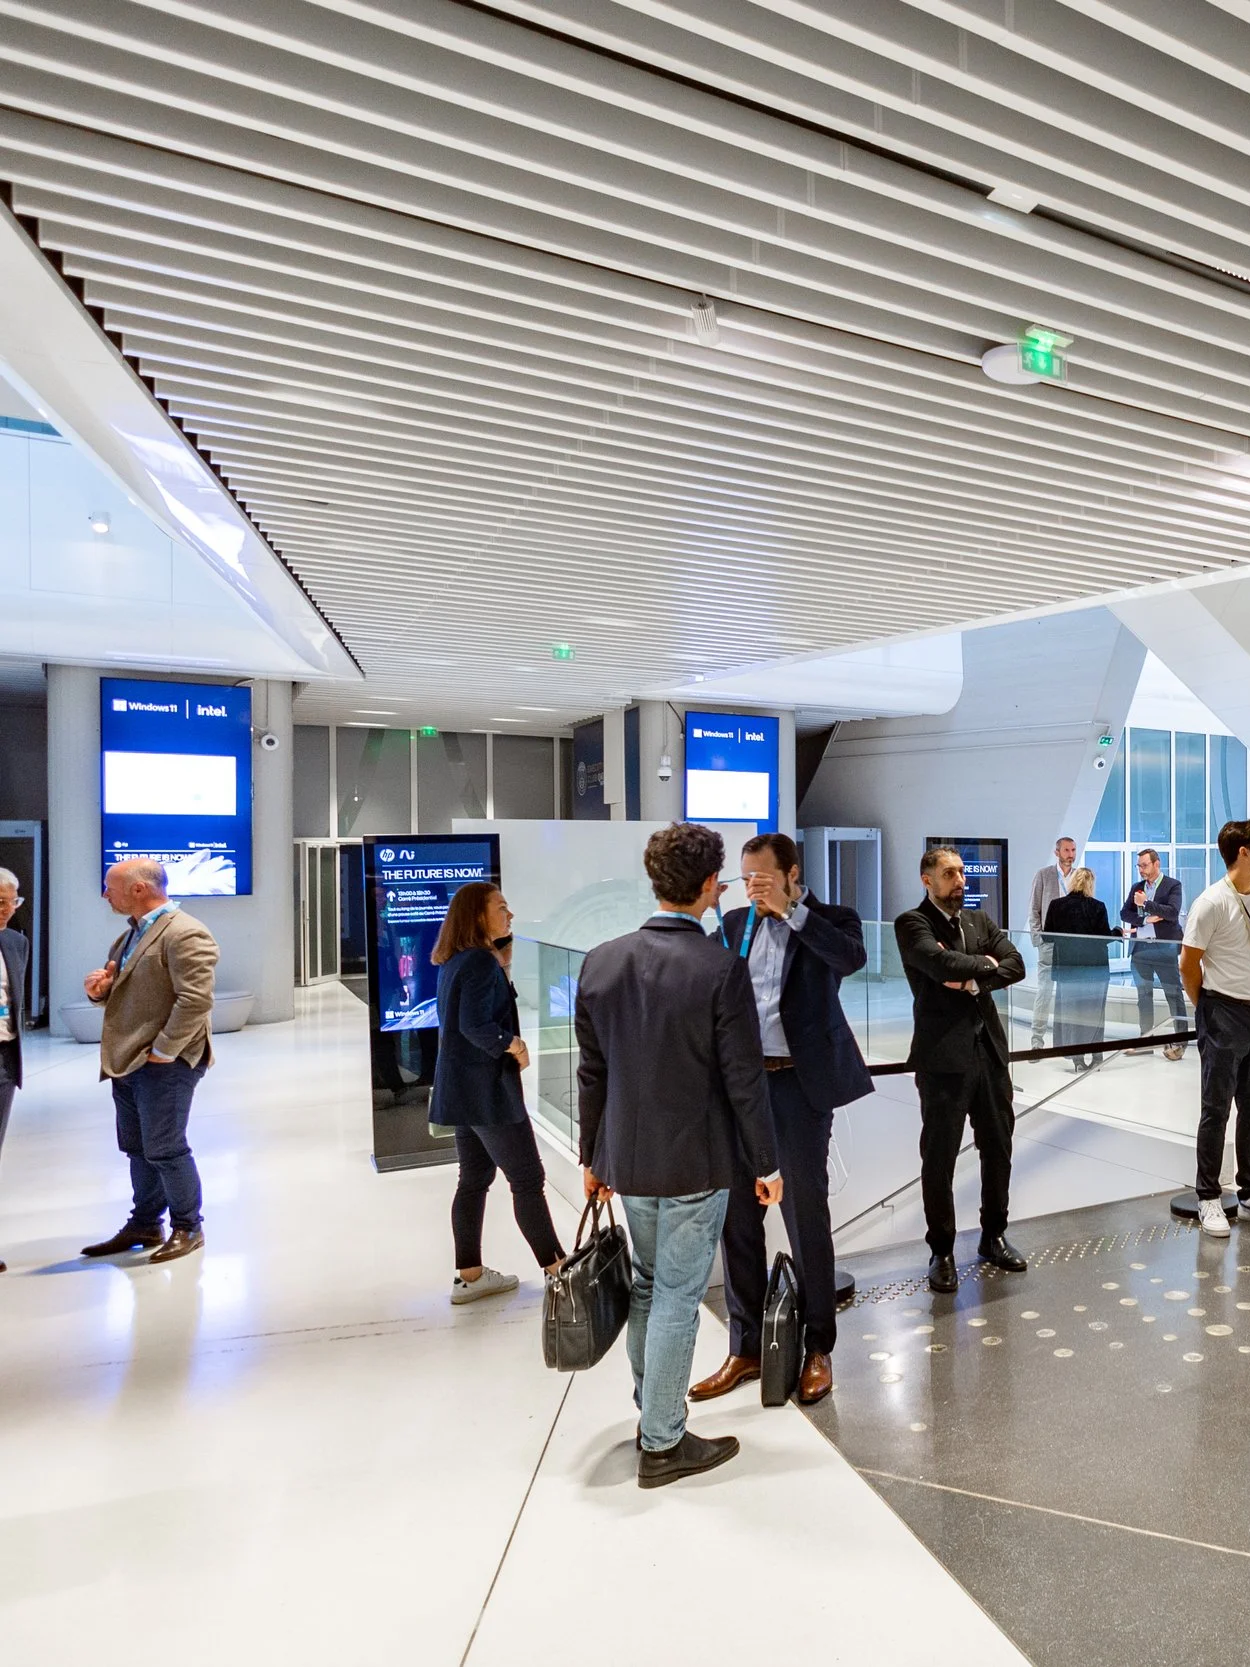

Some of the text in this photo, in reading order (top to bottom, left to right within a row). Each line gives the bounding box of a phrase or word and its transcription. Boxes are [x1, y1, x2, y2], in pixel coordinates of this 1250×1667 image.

[128, 702, 169, 712] Windows
[170, 704, 177, 712] 11
[381, 849, 394, 861] hp
[974, 865, 979, 873] IS
[382, 870, 403, 880] THE
[404, 869, 443, 879] FUTURE
[444, 869, 454, 878] IS
